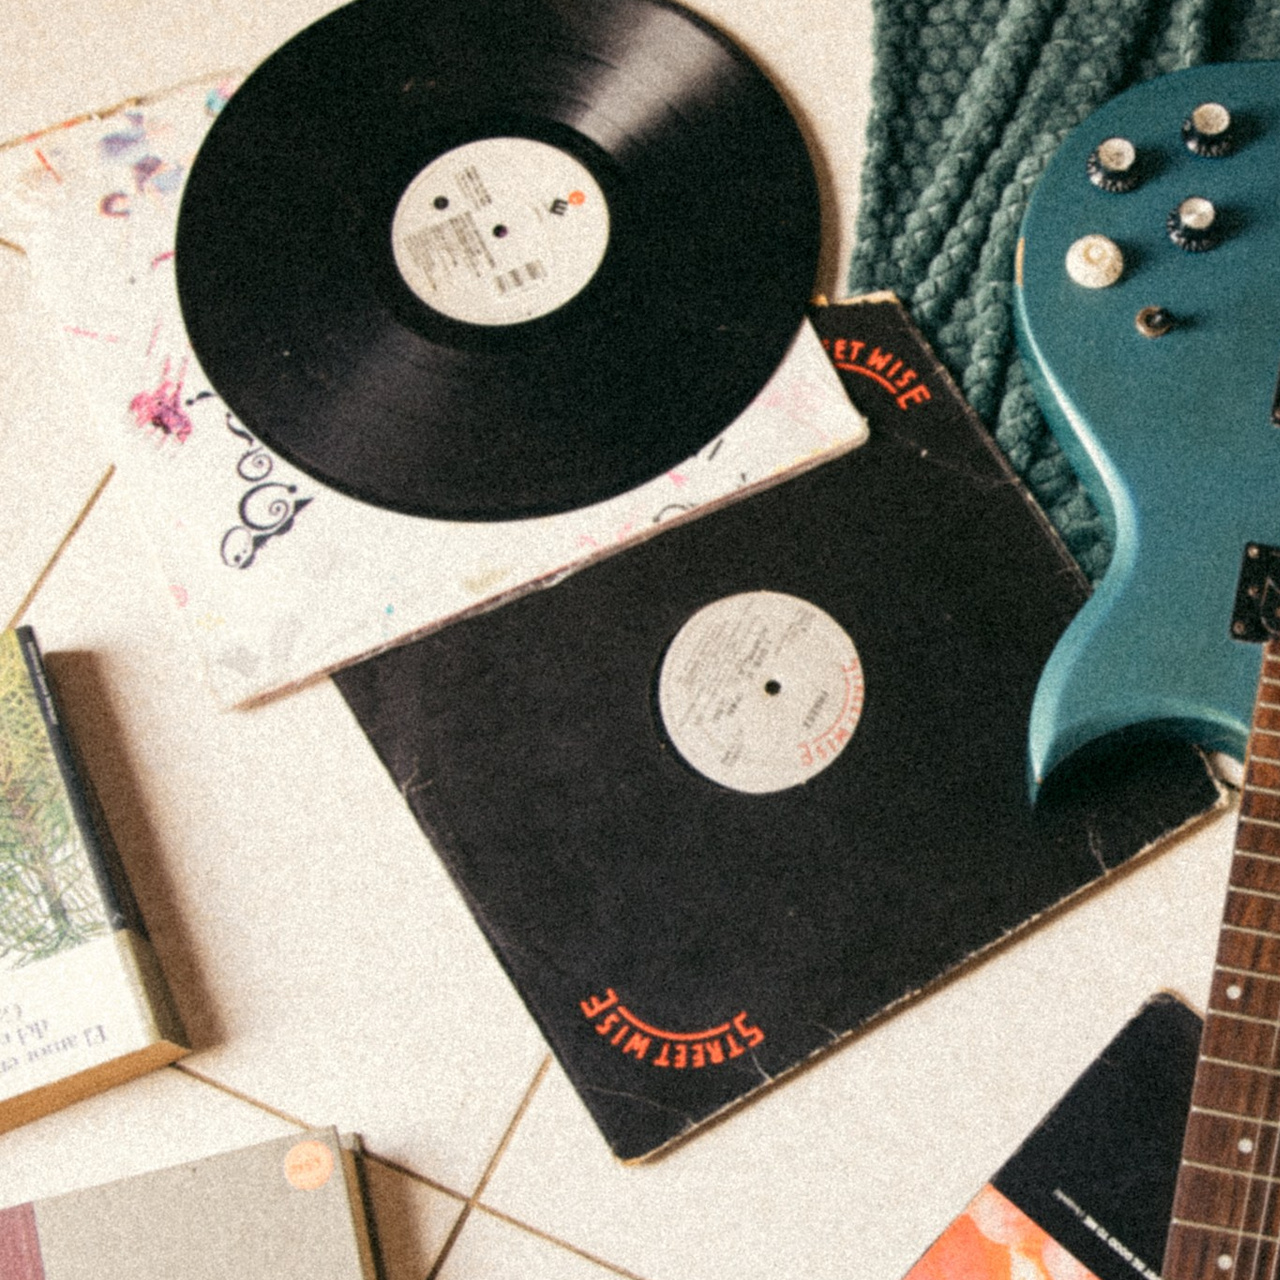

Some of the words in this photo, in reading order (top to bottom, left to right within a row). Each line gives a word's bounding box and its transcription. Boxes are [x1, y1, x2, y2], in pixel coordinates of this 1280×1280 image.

[866, 346, 932, 411] WISE
[579, 986, 652, 1061] WISE
[653, 1010, 765, 1069] STREET
